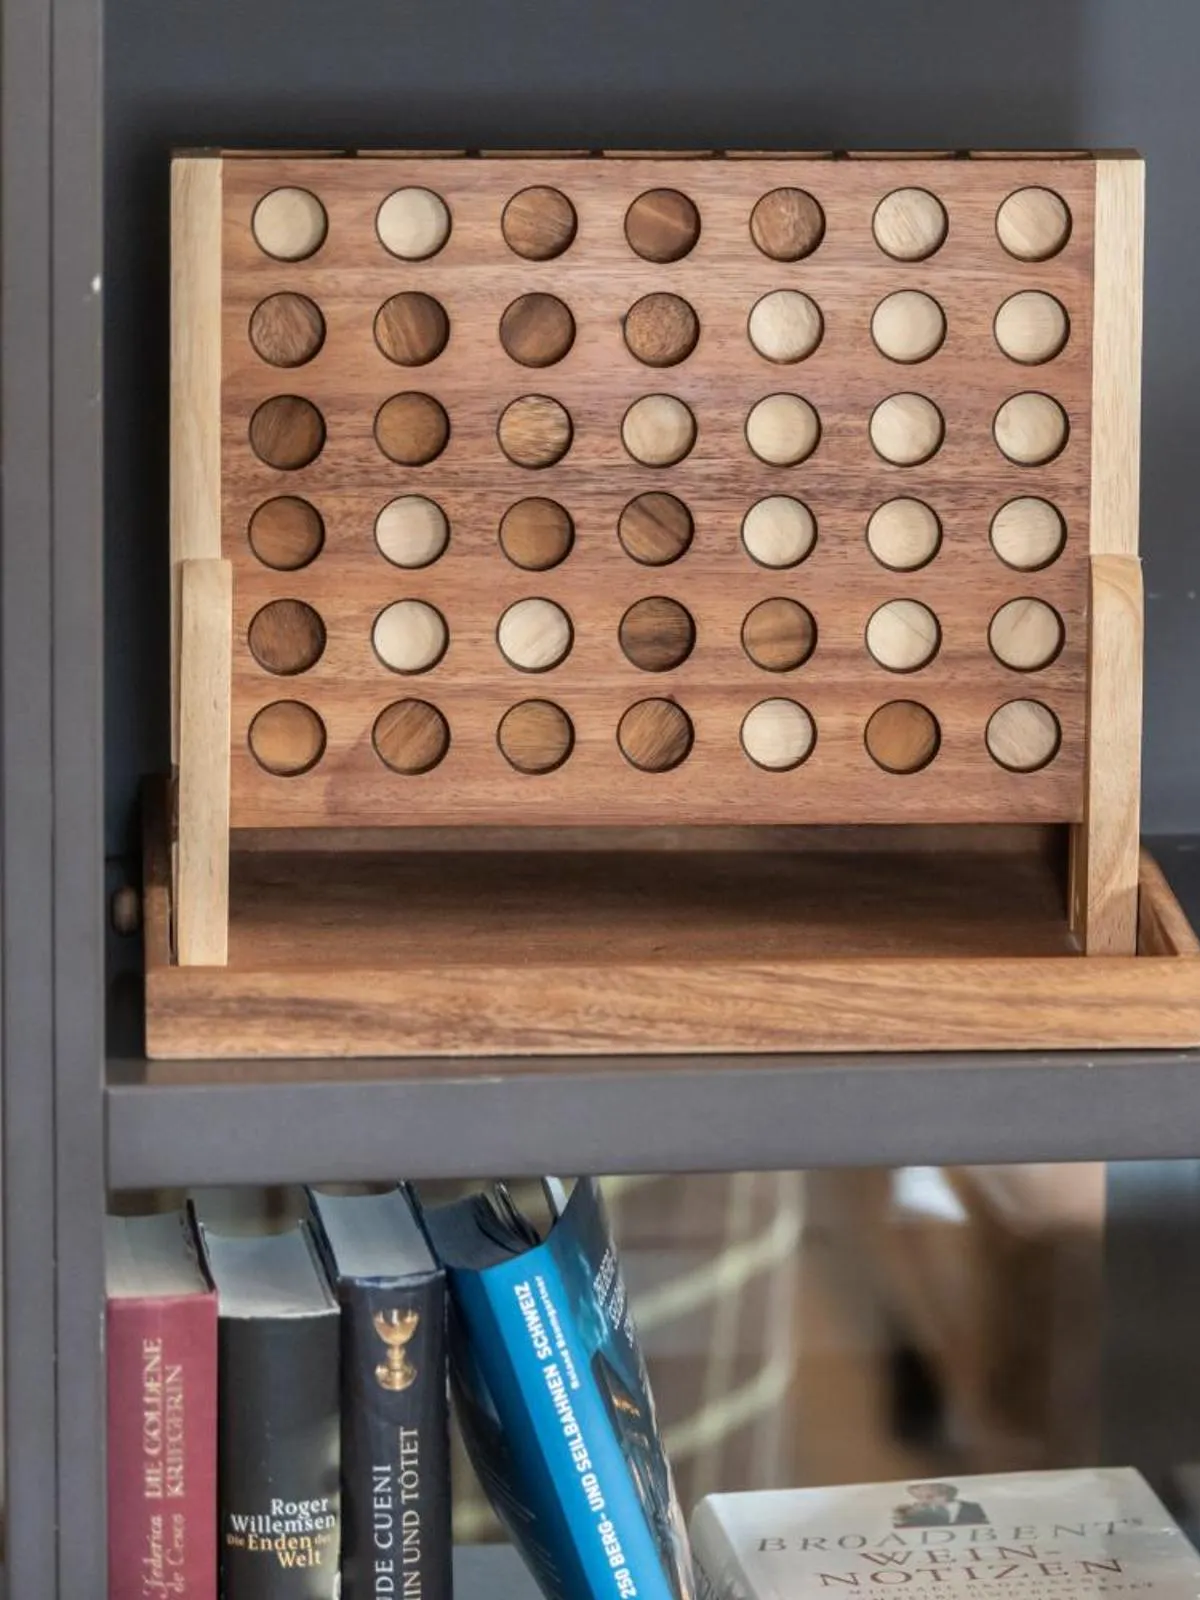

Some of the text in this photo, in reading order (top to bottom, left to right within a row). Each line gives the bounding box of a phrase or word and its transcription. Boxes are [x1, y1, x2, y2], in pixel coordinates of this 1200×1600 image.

[142, 1337, 163, 1498] DIE GOLDENE
[165, 1364, 185, 1498] KRIEGERIN
[513, 1281, 637, 1600] 250 BERG- UND SEILBAHNEN SCHWEIZ
[397, 1426, 420, 1505] TÖTET
[230, 1513, 336, 1534] Willemsen
[271, 1498, 328, 1519] Roger
[372, 1464, 394, 1550] CUENI
[142, 1514, 168, 1598] Federica
[247, 1533, 312, 1551] Enden
[276, 1548, 322, 1569] Welt
[401, 1509, 421, 1564] UND
[859, 1543, 1061, 1567] WEIN-
[818, 1558, 1124, 1588] NOTIZEN
